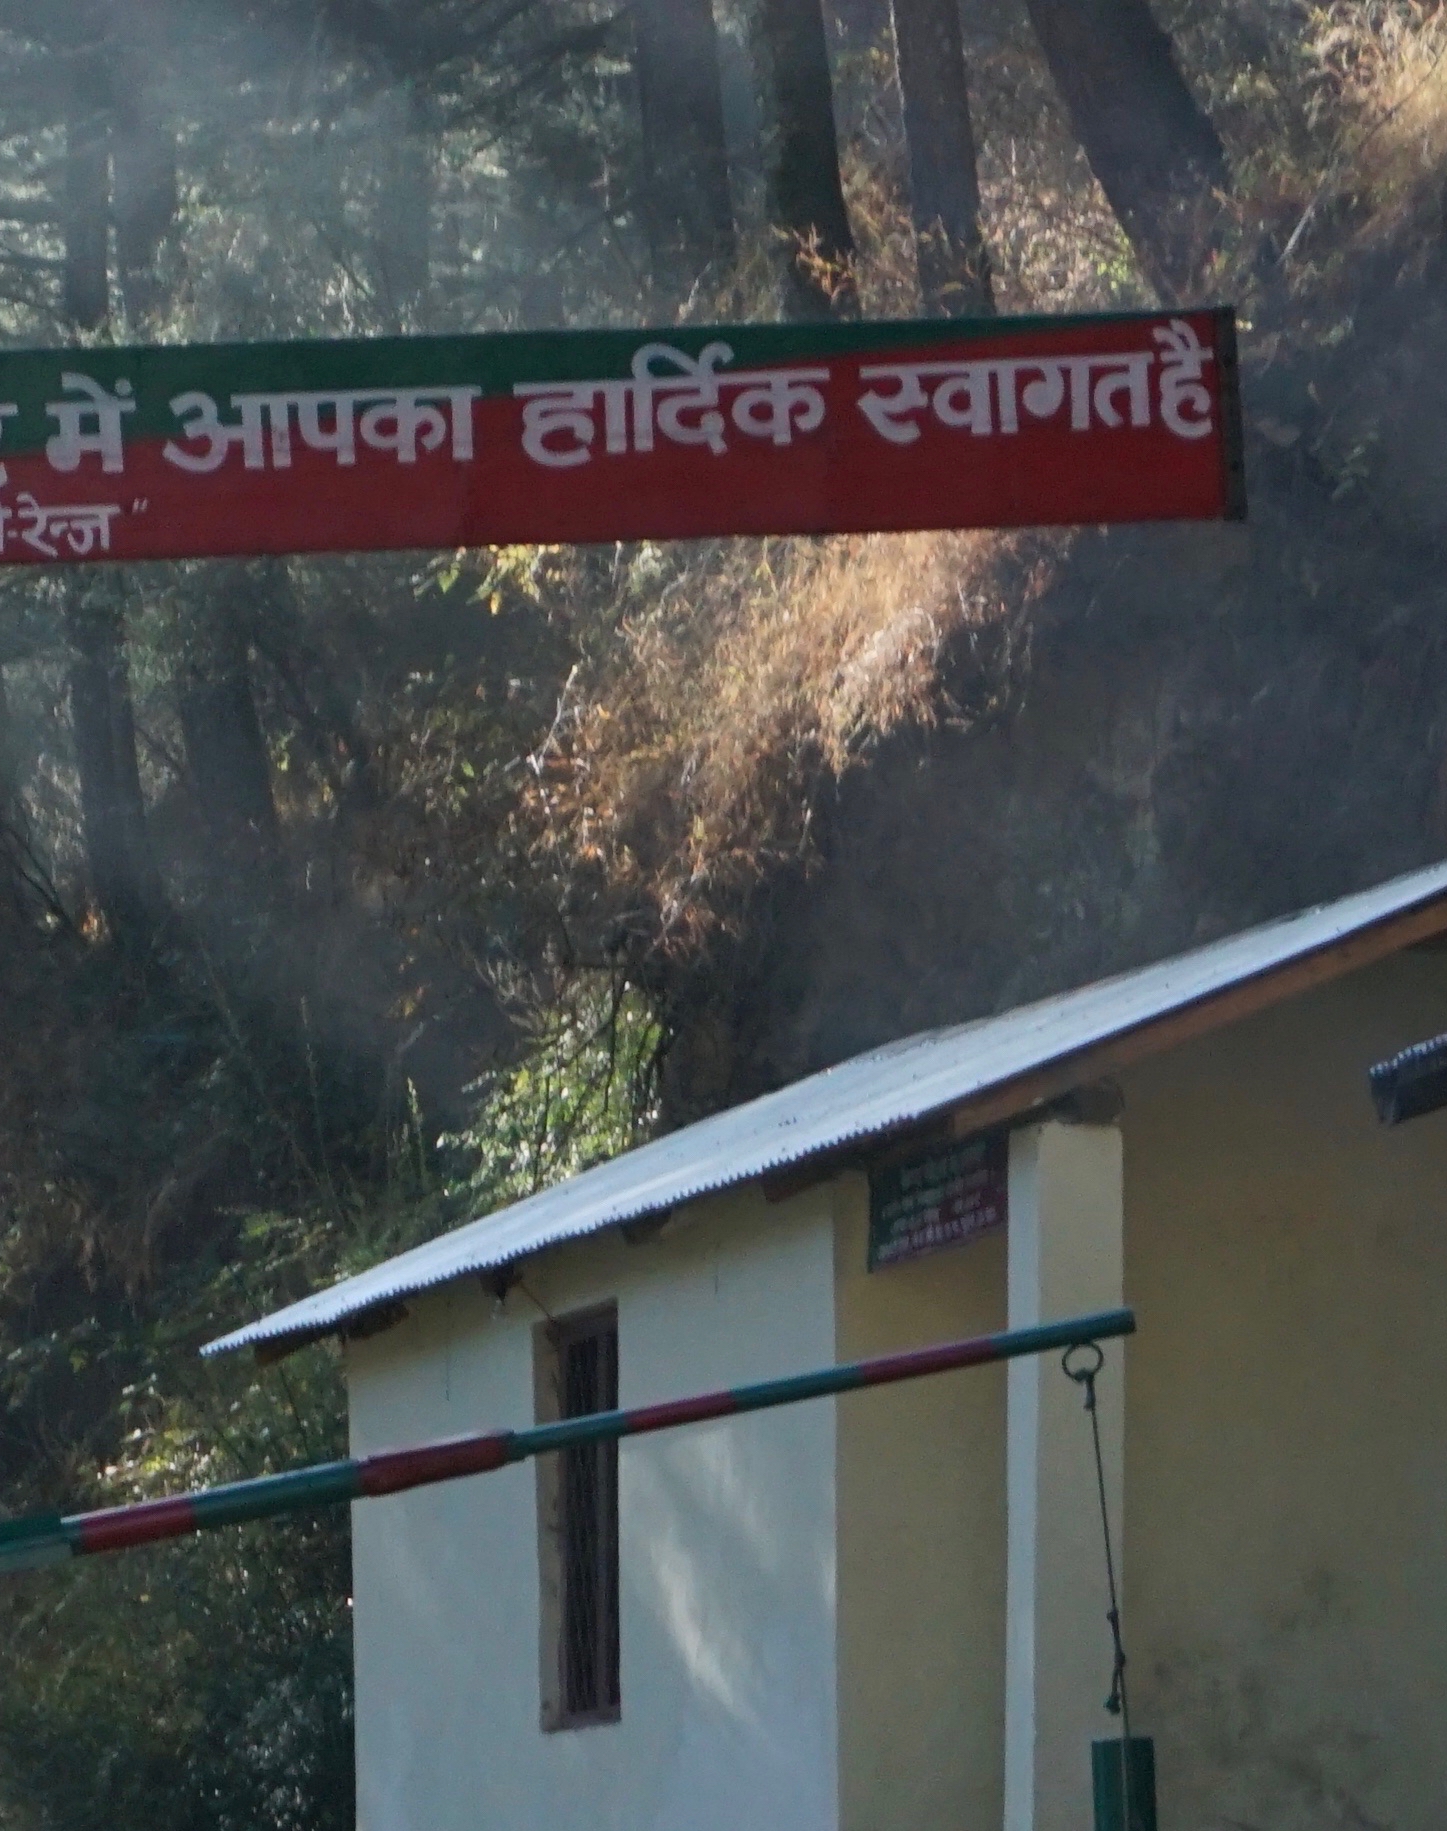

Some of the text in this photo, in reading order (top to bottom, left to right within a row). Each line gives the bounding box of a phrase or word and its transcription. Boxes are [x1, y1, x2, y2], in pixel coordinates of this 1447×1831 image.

[46, 371, 128, 474] में
[163, 382, 481, 475] आपका
[514, 342, 830, 468] हार्दिक
